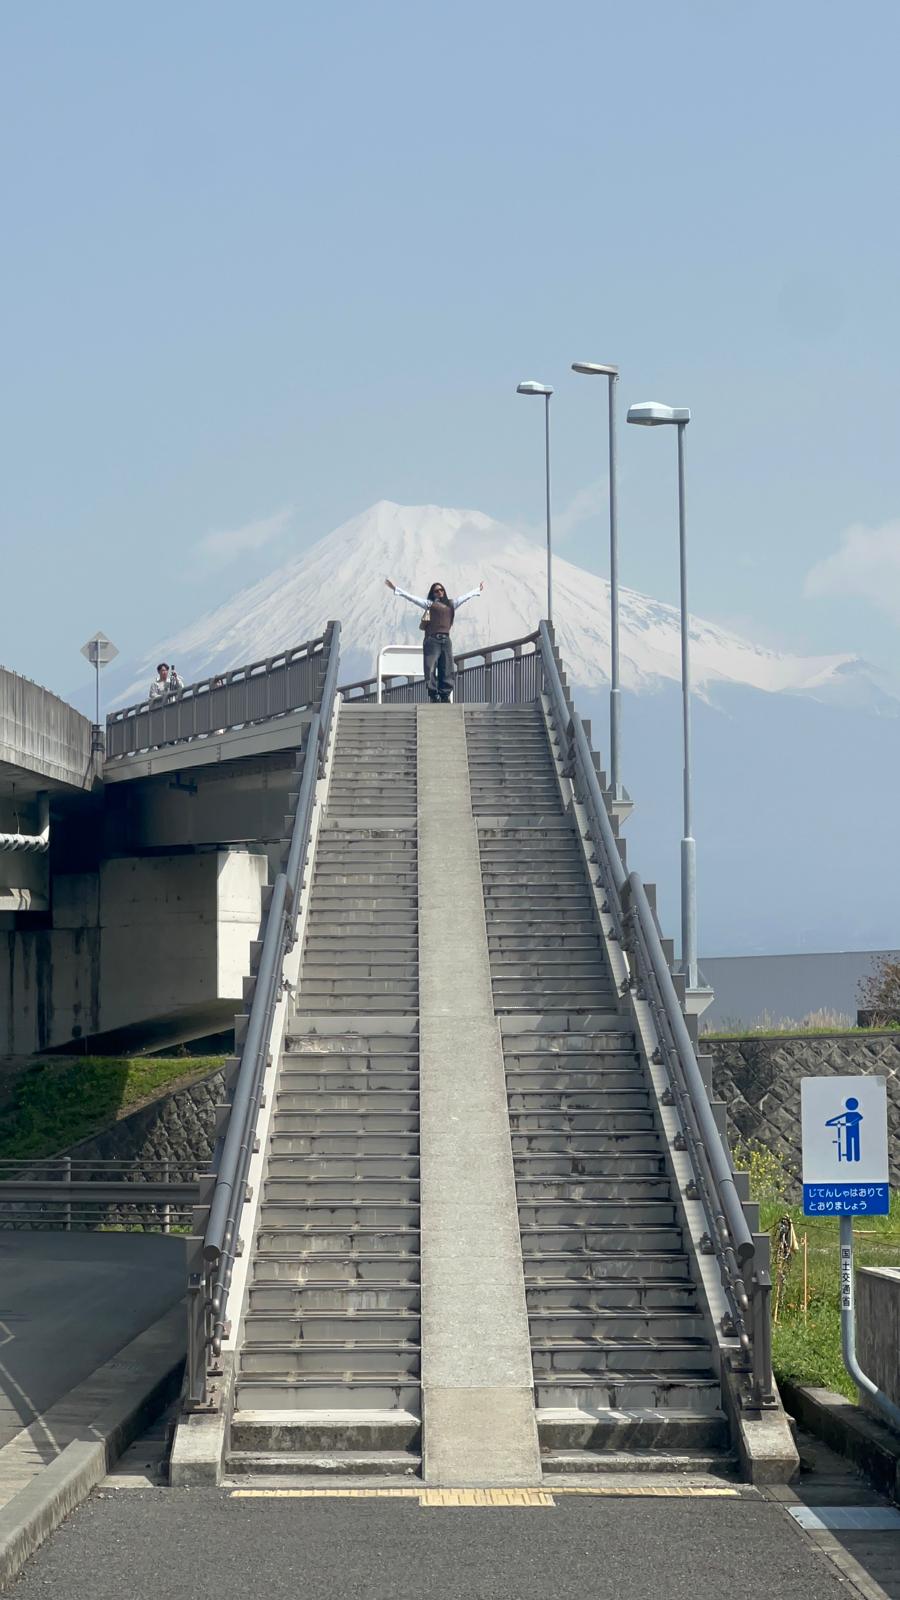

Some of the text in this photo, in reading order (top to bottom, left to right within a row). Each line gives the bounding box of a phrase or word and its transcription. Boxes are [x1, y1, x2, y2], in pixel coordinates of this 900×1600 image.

[808, 1187, 884, 1198] じてんしゃはおりて
[808, 1201, 867, 1211] とおりましょう
[842, 1248, 850, 1307] 国土交通省
